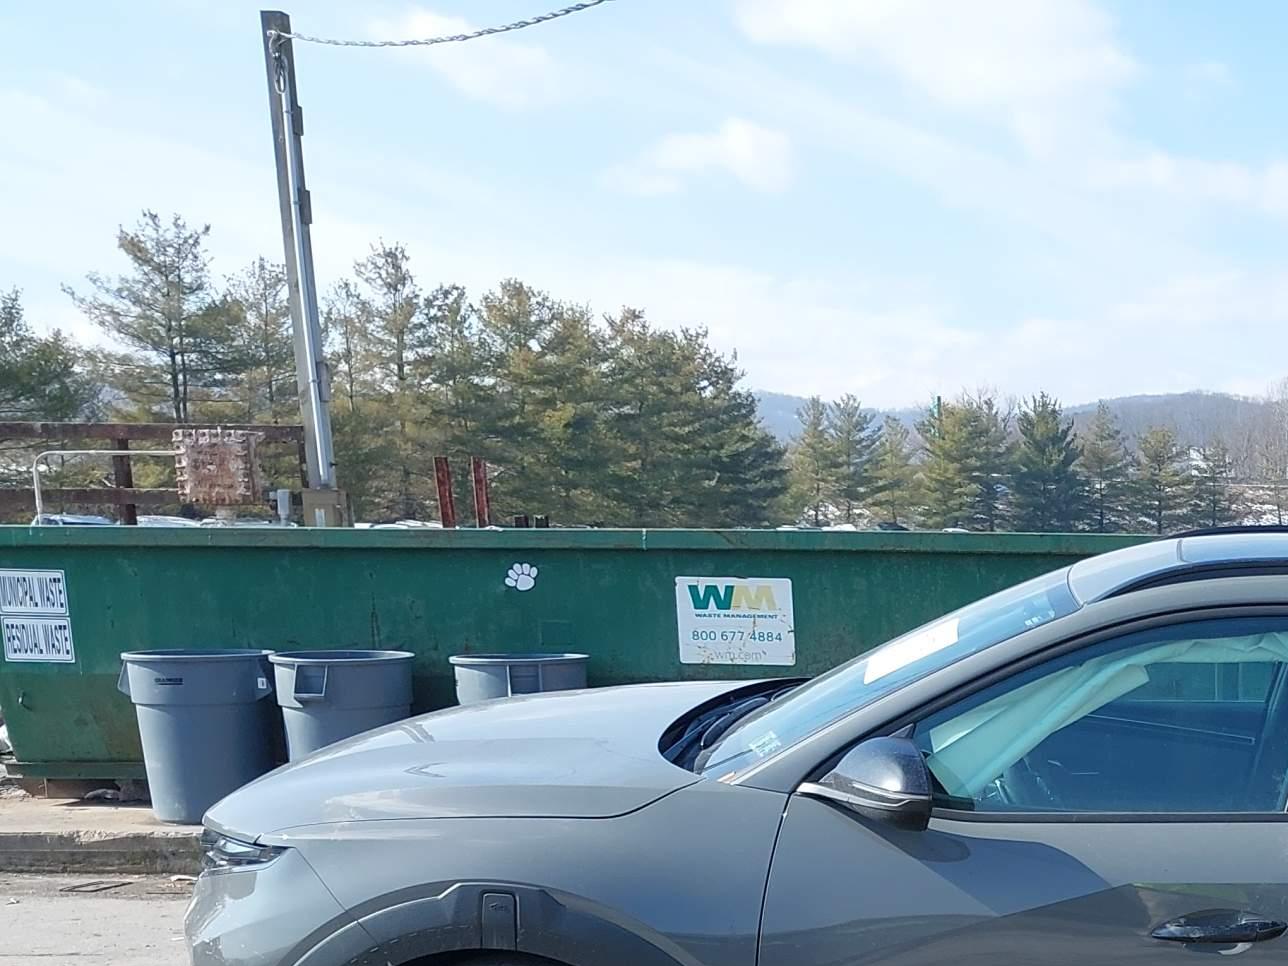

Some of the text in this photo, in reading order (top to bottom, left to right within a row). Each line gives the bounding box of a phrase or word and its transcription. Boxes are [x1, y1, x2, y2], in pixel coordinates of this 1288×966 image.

[38, 576, 65, 608] WASTE
[687, 585, 777, 610] WM
[6, 623, 70, 655] RESIDUAL WASTE
[692, 631, 783, 642] 800 677 4884
